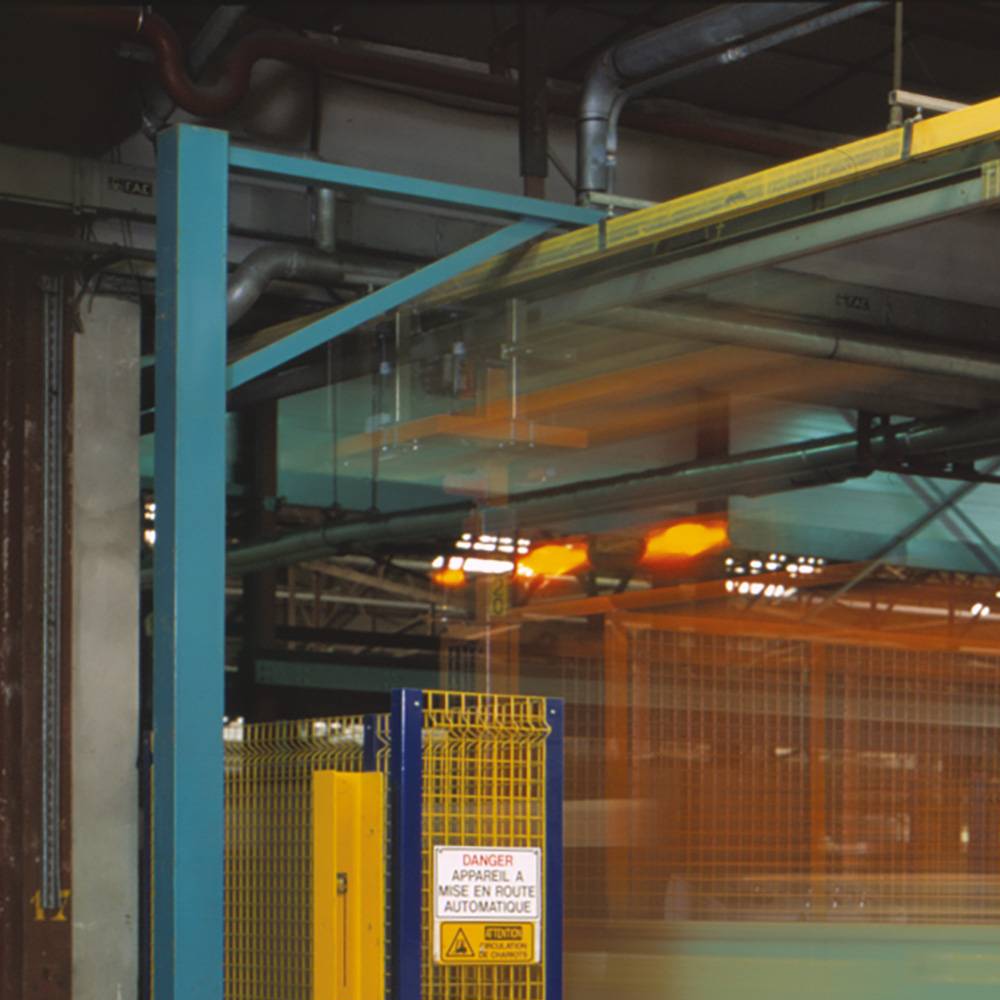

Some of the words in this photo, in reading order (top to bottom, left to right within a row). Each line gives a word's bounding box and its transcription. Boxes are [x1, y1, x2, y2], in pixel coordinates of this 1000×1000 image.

[463, 854, 513, 866] DANGER
[452, 869, 510, 882] APPAREIL
[439, 885, 469, 897] MISE
[474, 886, 491, 897] EN
[496, 886, 535, 898] ROUTE
[444, 901, 531, 913] AUTOMATIQUE
